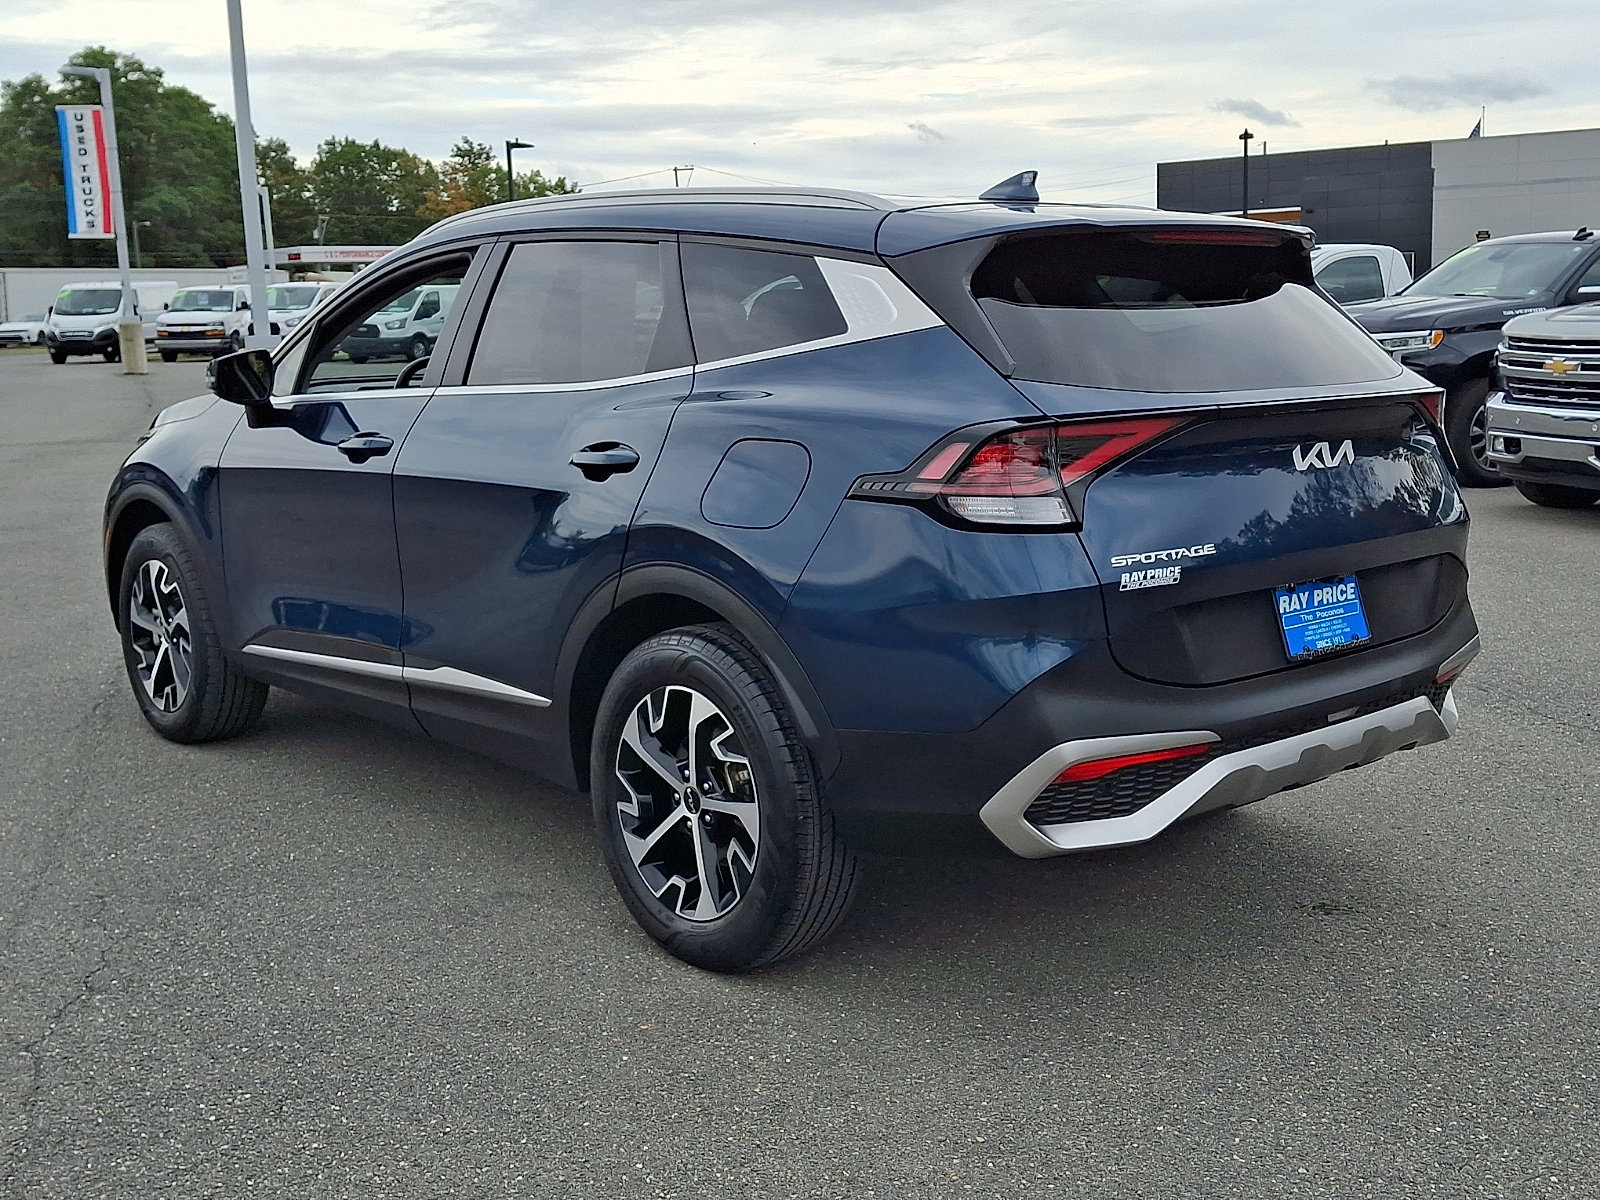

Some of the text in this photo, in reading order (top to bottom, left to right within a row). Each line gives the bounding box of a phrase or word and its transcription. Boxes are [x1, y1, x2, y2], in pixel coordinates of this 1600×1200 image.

[74, 112, 95, 228] USED TRUCKS
[1292, 439, 1355, 471] KIA
[1111, 544, 1216, 567] SPORTAGE
[1121, 566, 1181, 583] RAY PRICE
[1280, 583, 1355, 613] RAY PRICE
[1316, 608, 1344, 618] Poconos
